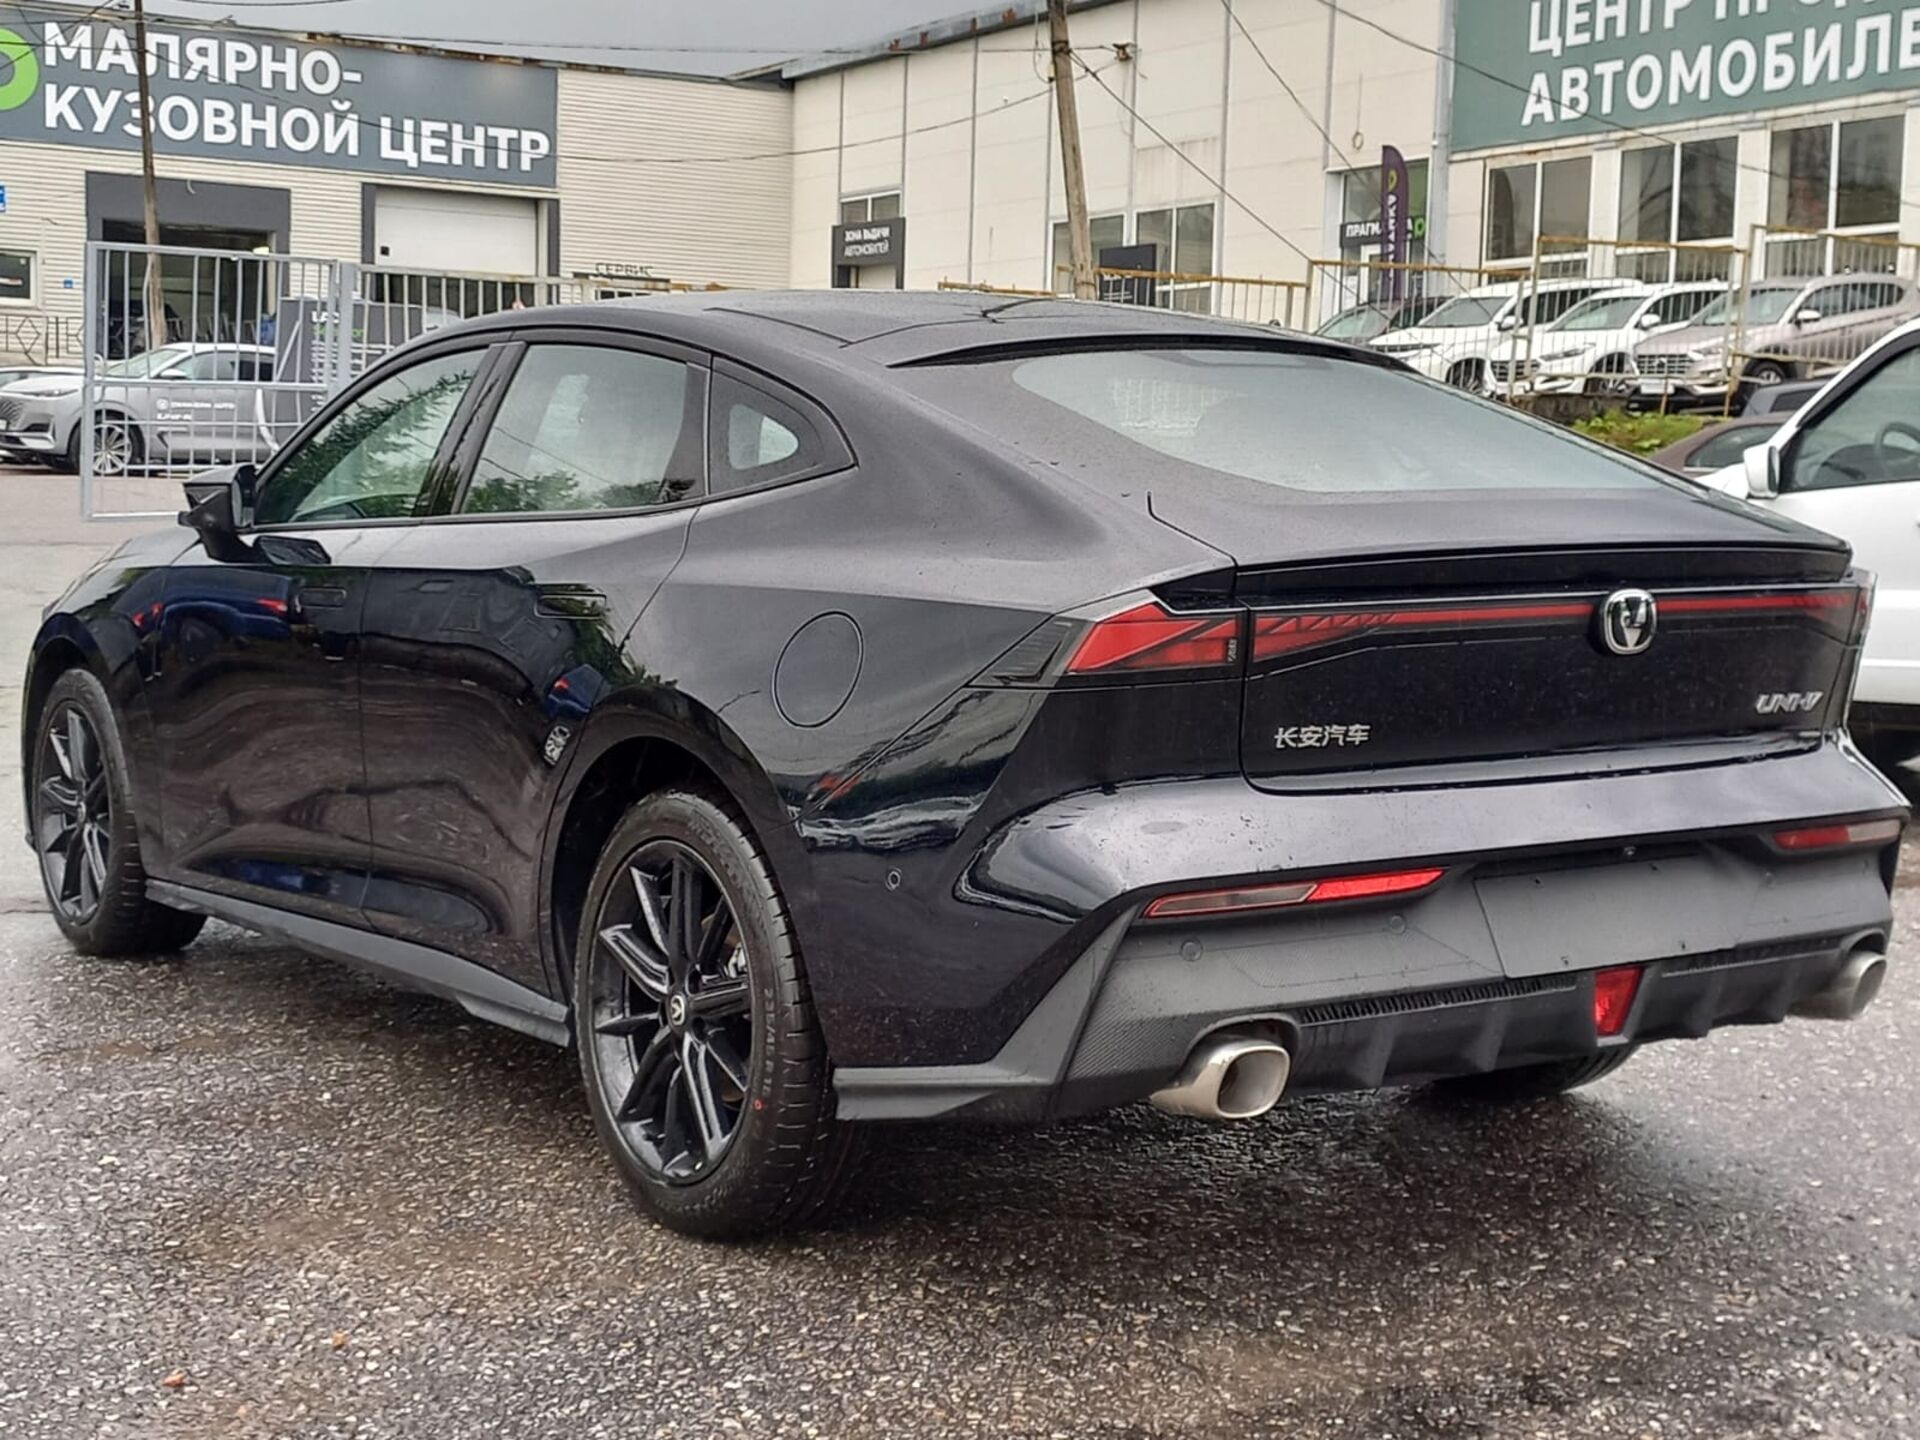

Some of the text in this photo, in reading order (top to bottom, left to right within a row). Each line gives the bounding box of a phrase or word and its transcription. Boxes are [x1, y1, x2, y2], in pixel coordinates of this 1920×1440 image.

[43, 22, 362, 95] МАЛЯРНО-
[1521, 8, 1920, 126] АВТОМОБИЛЕ
[43, 83, 550, 170] КУЗОВНОЙ ЦЕНТР
[1273, 723, 1371, 749] 长安汽车
[1756, 691, 1824, 714] UNI-V
